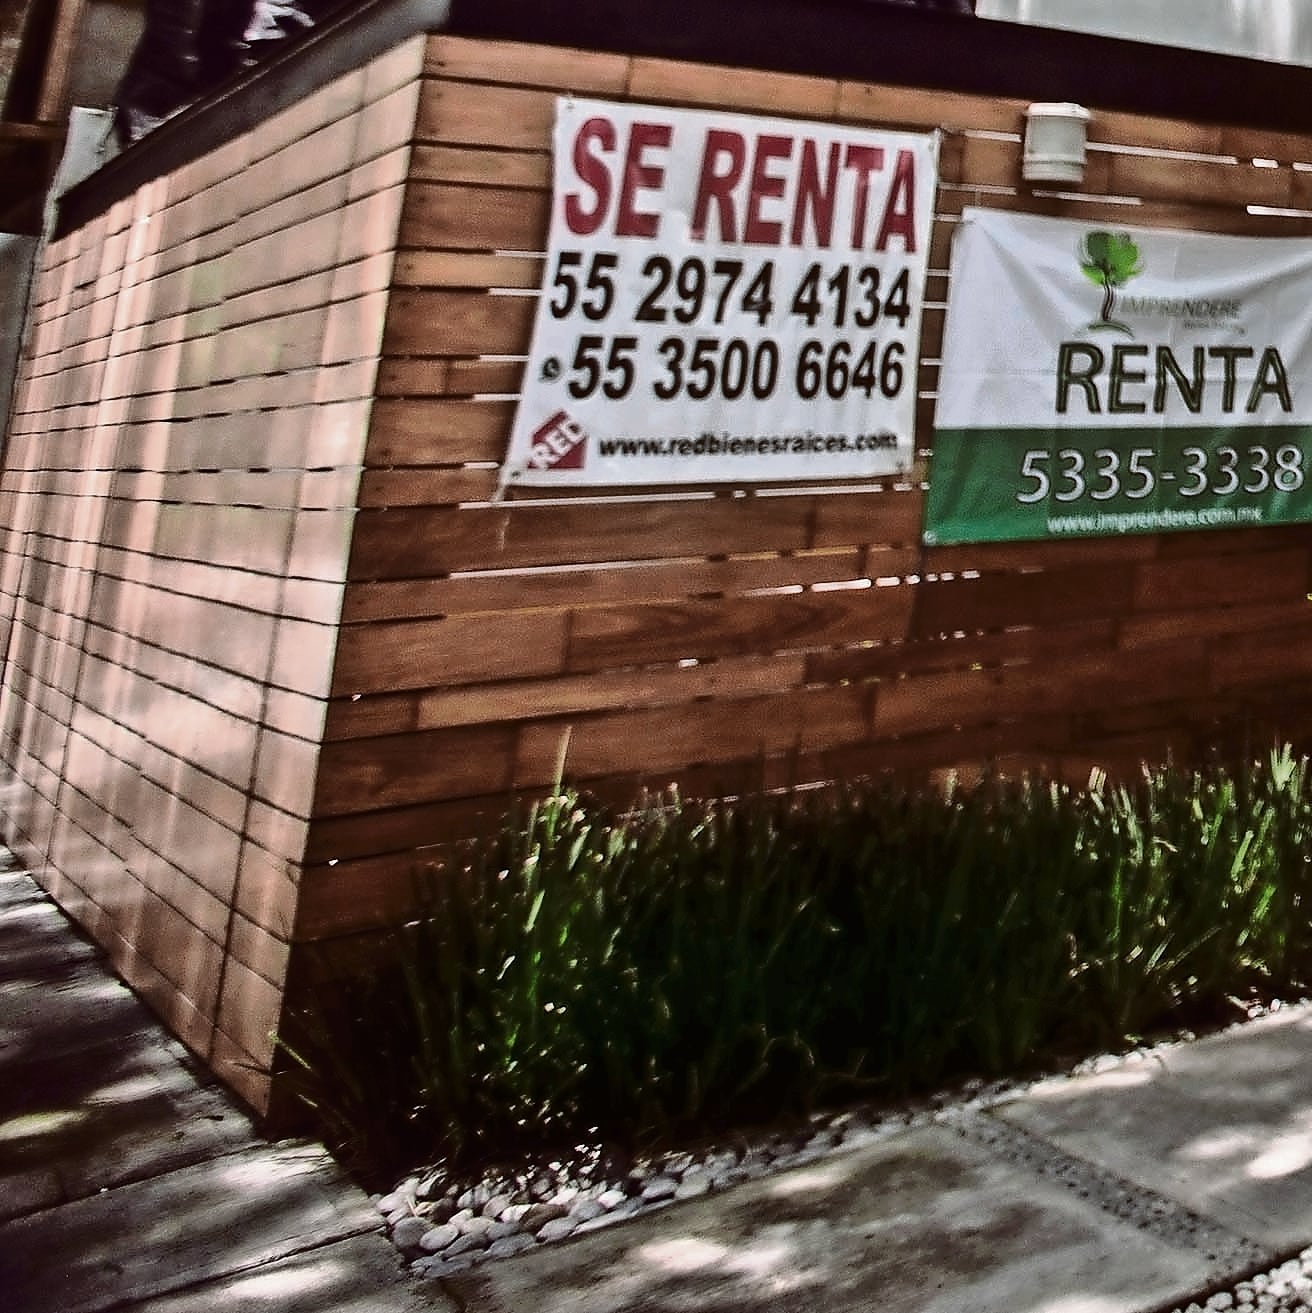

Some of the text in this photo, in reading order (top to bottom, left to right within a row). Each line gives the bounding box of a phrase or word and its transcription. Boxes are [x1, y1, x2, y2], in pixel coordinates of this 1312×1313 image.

[565, 118, 917, 253] SE RENTA
[550, 252, 911, 329] 55 2974 4134
[568, 337, 905, 401] 55 3500 6646
[1056, 343, 1291, 414] RENTA
[532, 420, 587, 469] RED
[599, 431, 898, 458] www.redbienesraices.com
[1017, 445, 1303, 503] 5335-3338
